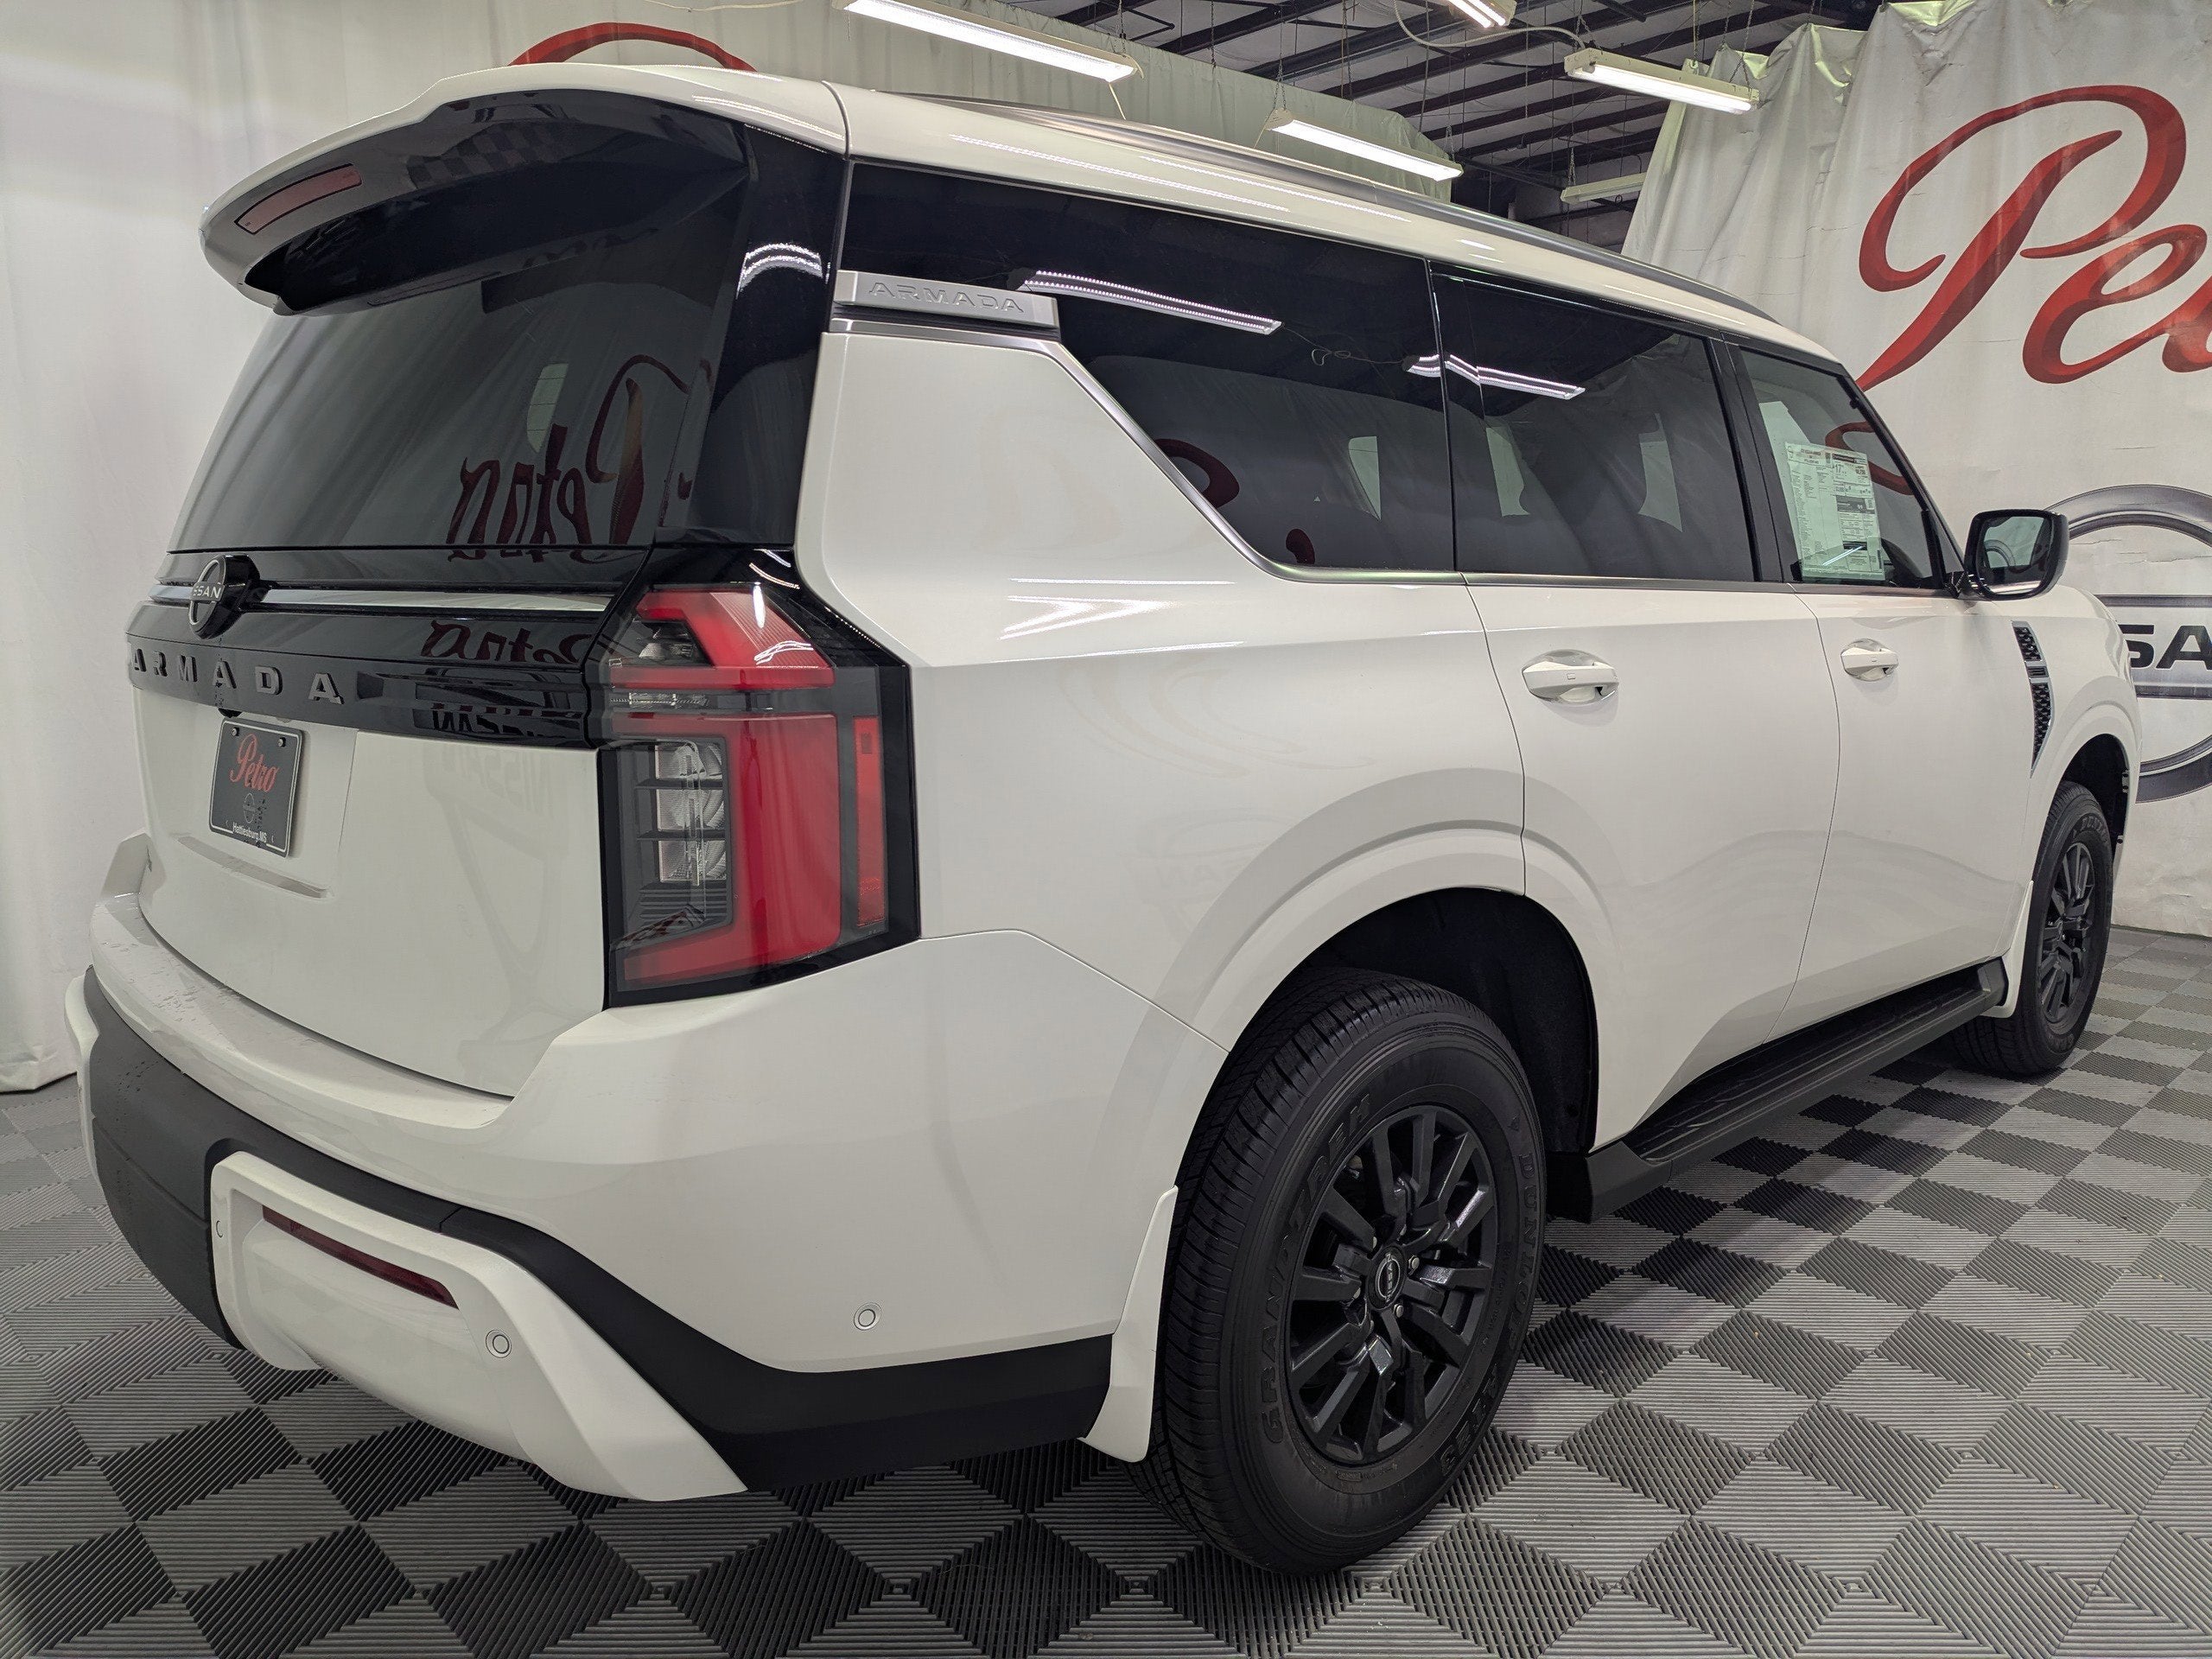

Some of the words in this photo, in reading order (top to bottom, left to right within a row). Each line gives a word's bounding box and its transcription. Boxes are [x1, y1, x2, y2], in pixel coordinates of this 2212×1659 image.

[868, 281, 1025, 314] ARMADA
[131, 648, 345, 705] ARMADA
[229, 733, 280, 793] Petro
